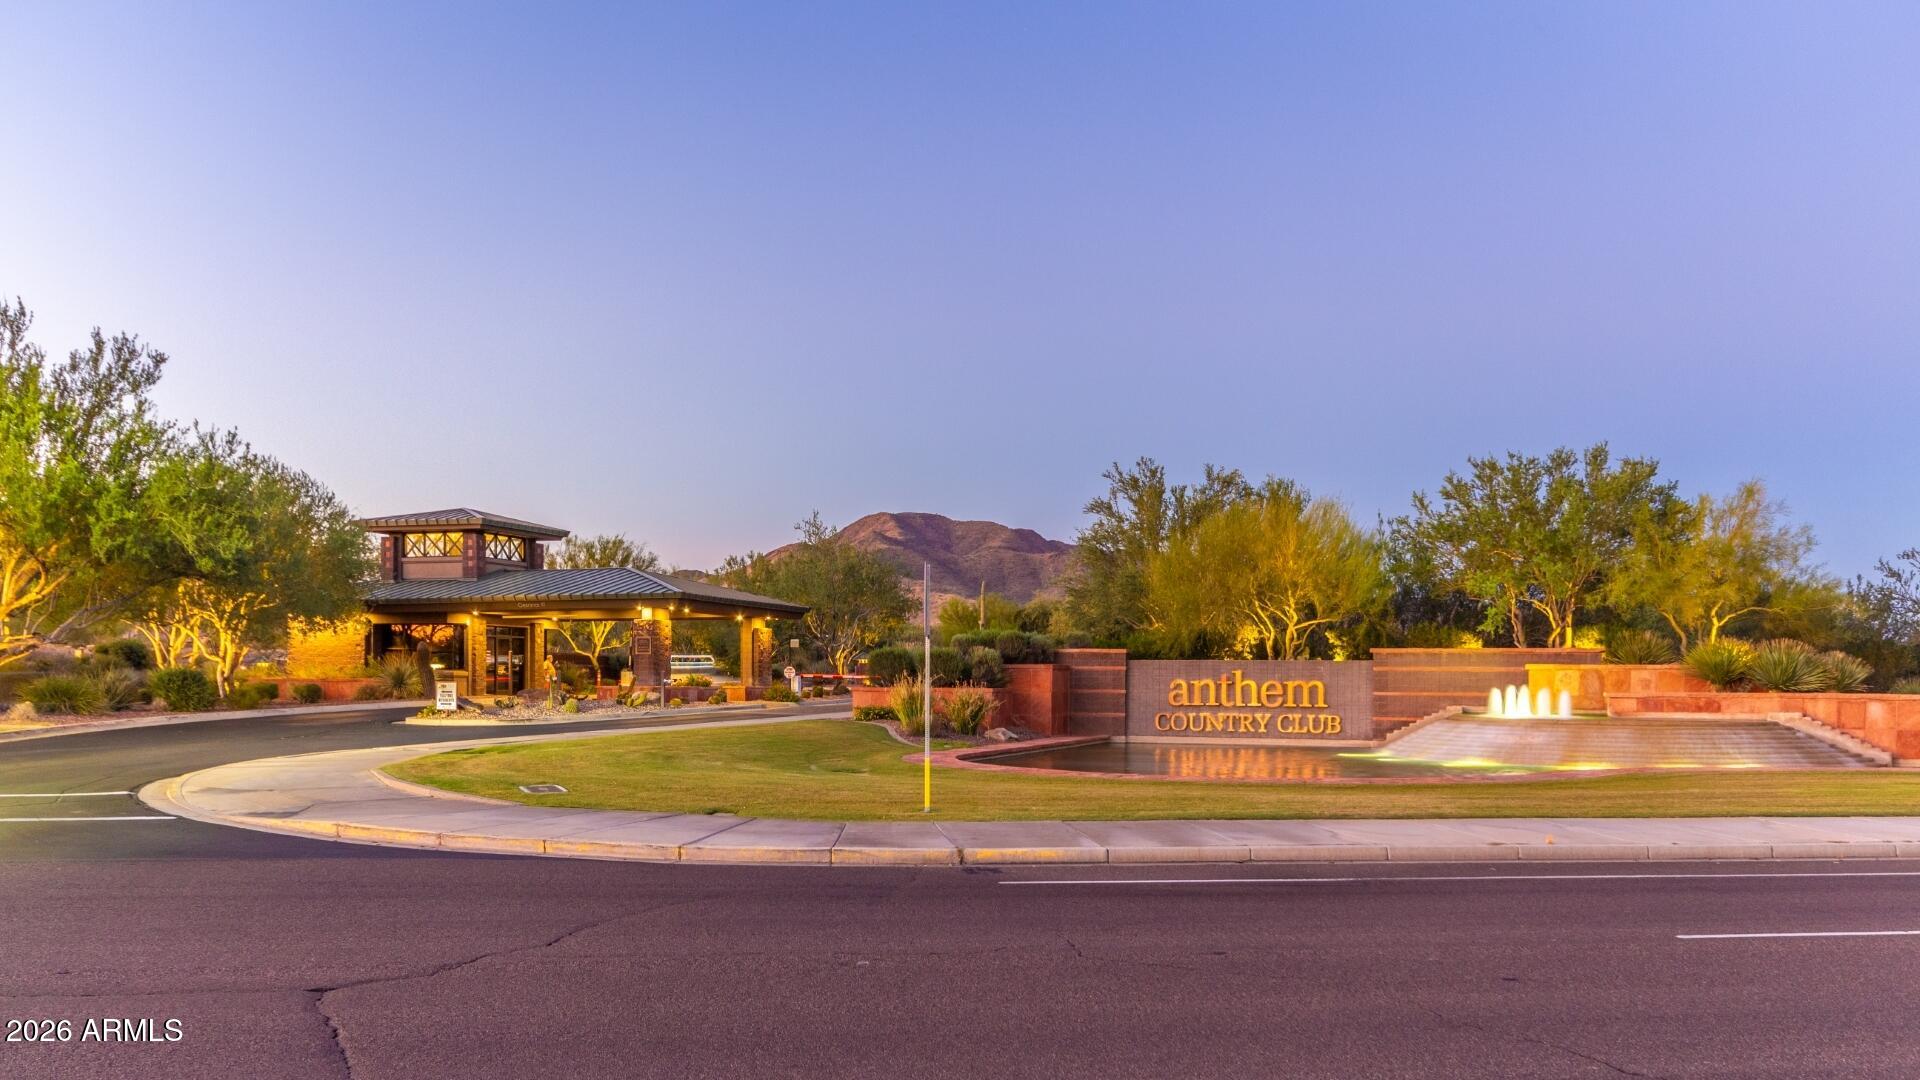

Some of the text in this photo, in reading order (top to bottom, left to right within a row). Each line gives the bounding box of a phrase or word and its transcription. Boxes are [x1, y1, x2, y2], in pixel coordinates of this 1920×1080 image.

[1168, 669, 1329, 708] anthem
[1155, 711, 1342, 734] COUNTRY CLUB
